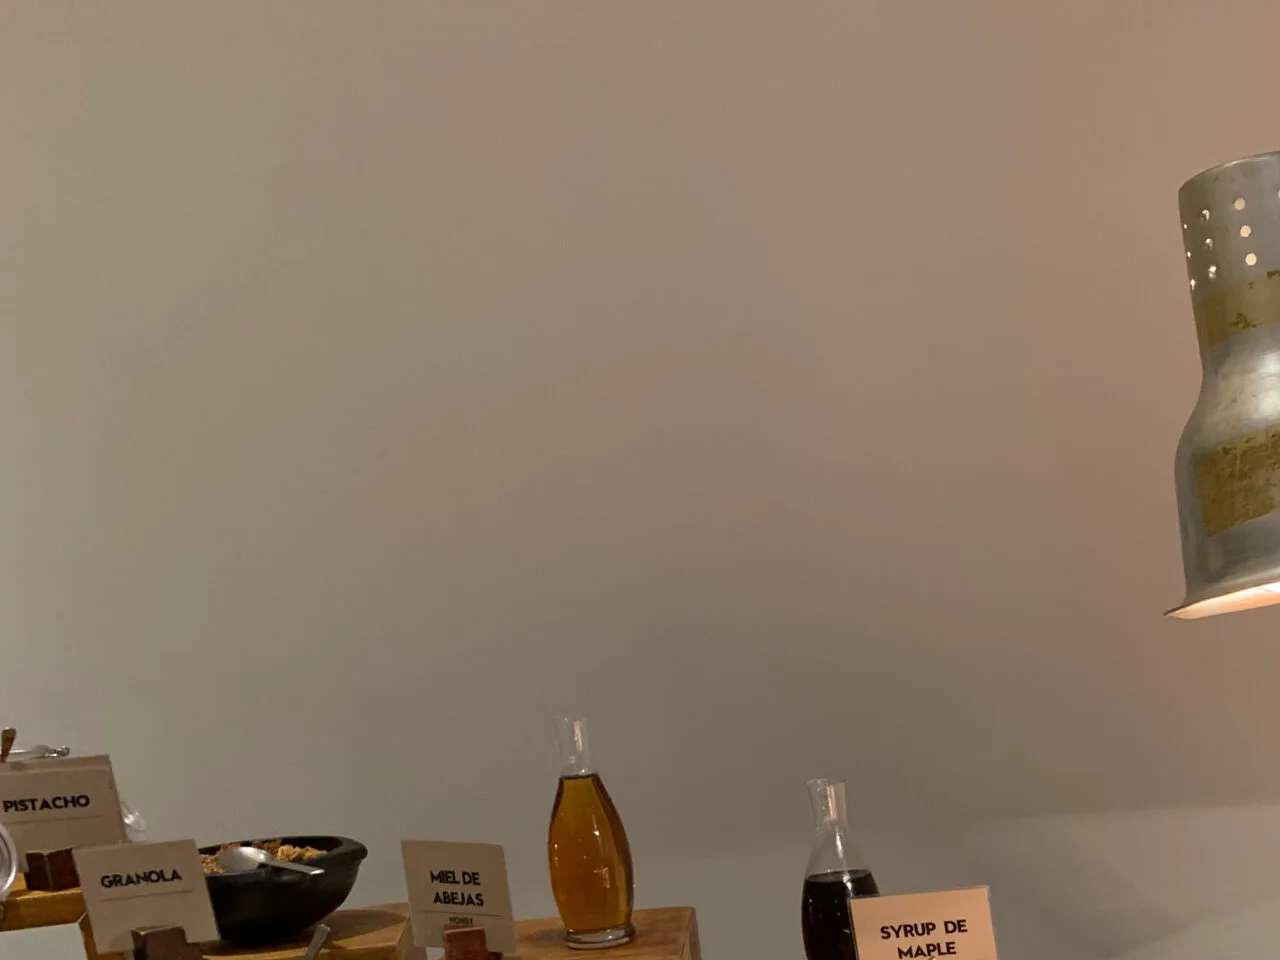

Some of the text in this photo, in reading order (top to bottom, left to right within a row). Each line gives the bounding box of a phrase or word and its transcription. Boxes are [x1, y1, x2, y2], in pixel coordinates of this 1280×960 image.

[3, 794, 91, 813] PISTACHO
[101, 868, 182, 889] GRANOLA
[430, 869, 481, 886] MIEL DE
[434, 890, 485, 907] ABEJAS
[880, 919, 968, 940] SYRUP DE
[897, 941, 957, 959] MAPLE
